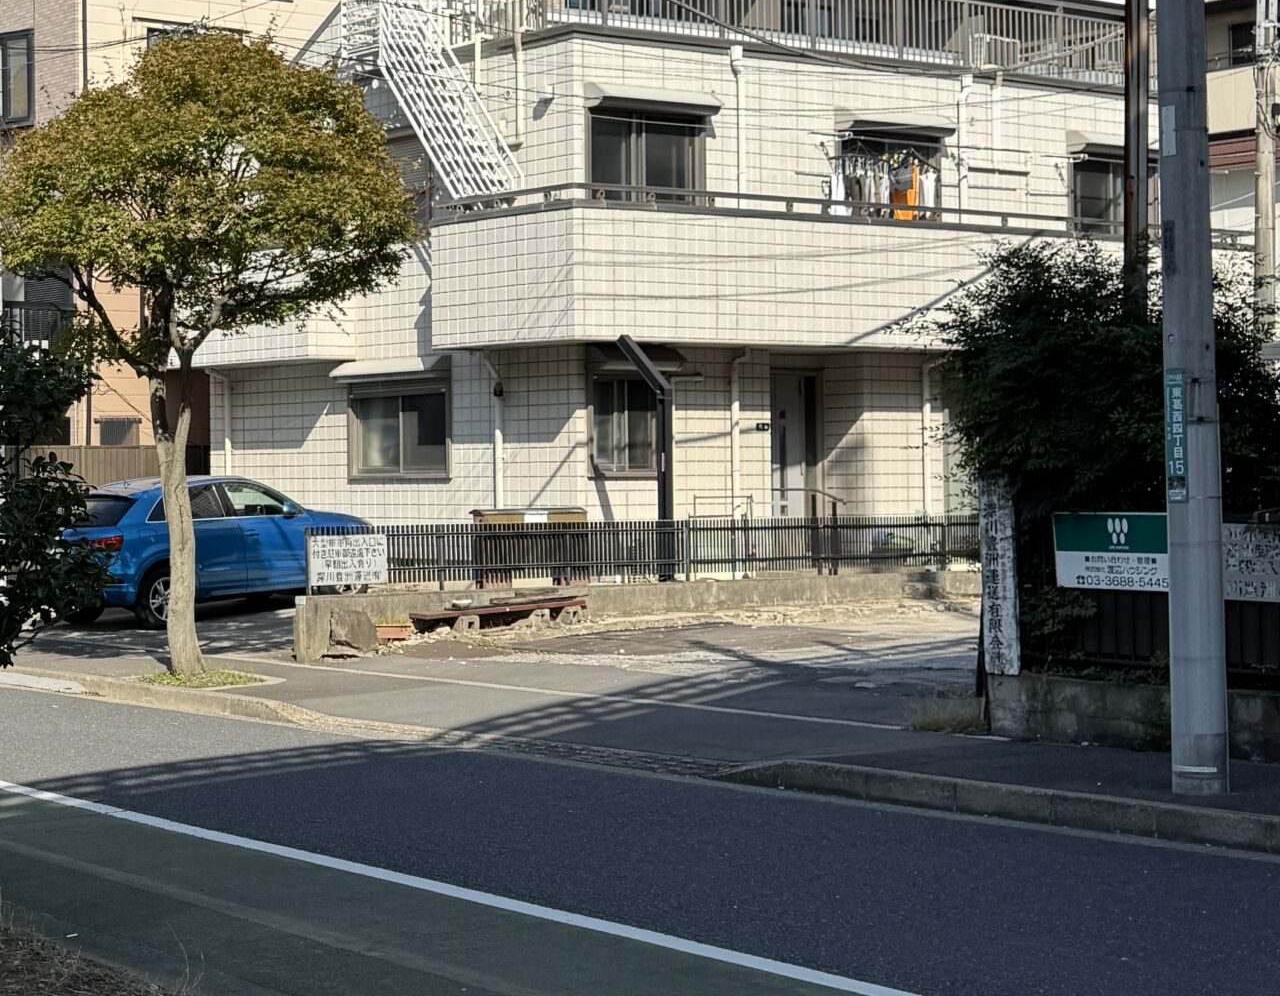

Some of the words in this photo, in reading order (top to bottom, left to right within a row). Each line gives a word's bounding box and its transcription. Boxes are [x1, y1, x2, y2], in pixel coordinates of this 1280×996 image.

[1172, 387, 1183, 458] 東葛西四丁目
[1169, 460, 1184, 475] 15
[1087, 575, 1169, 588] 03-3688-5445
